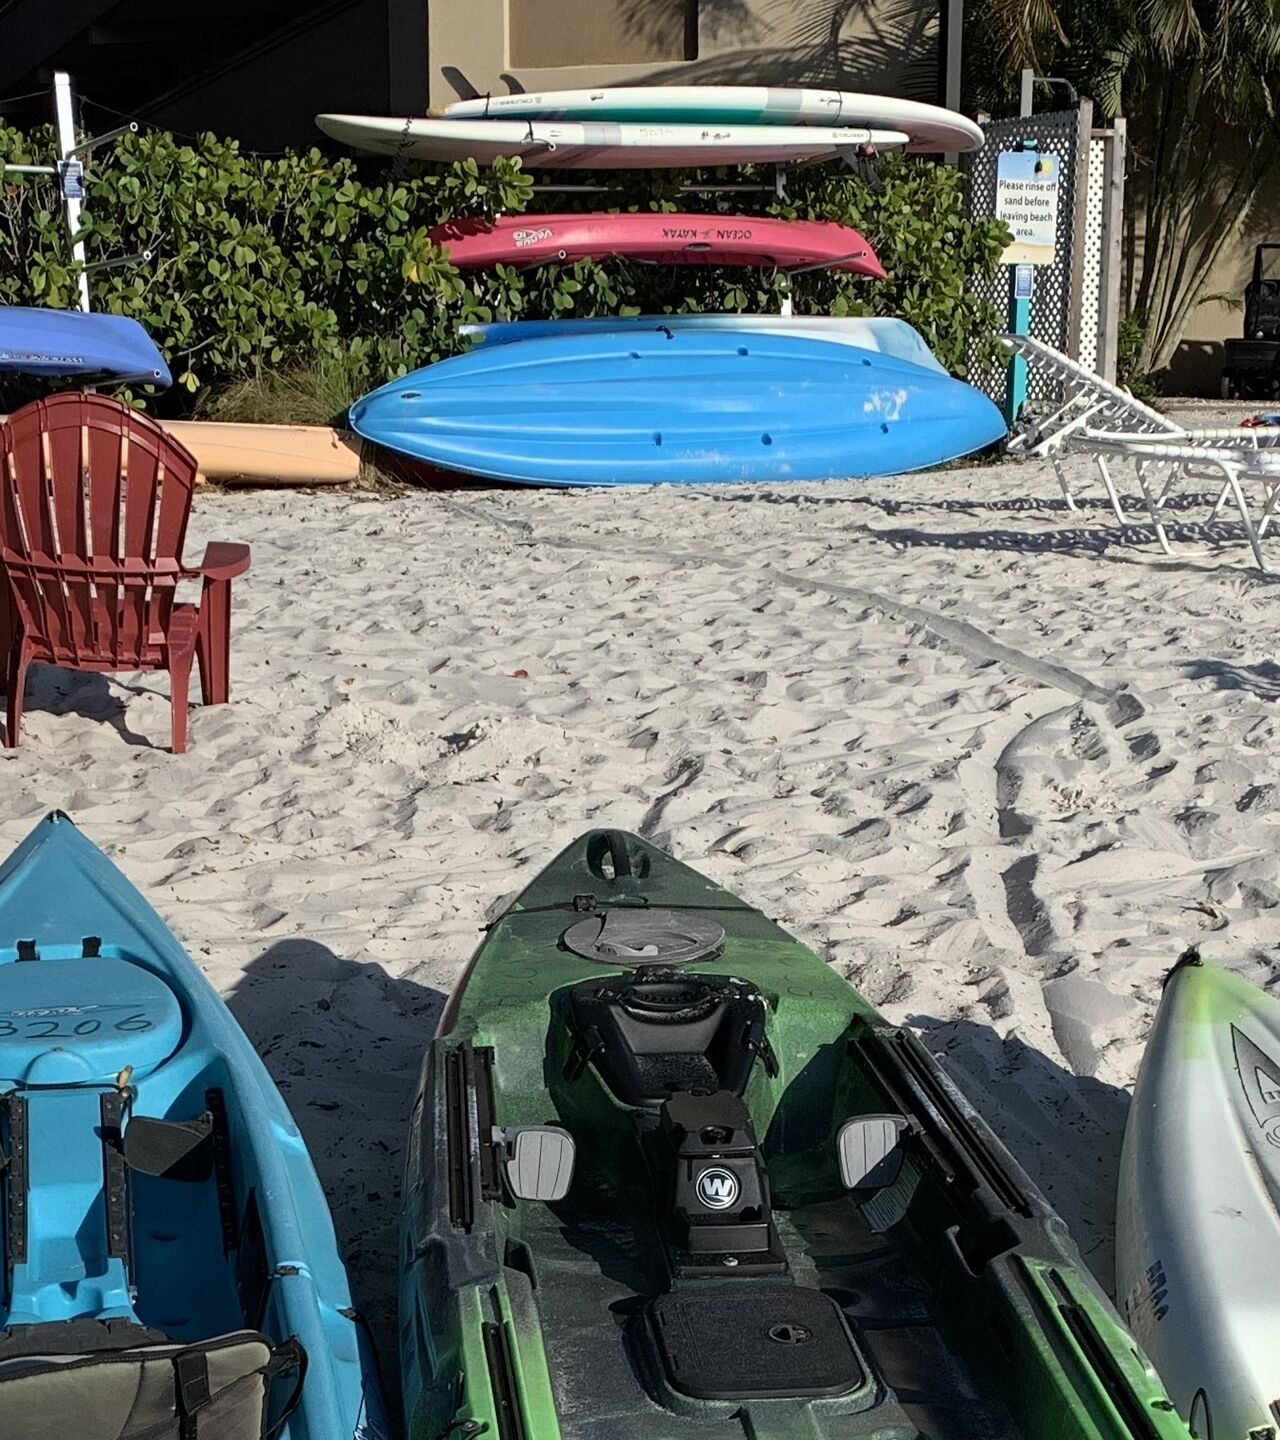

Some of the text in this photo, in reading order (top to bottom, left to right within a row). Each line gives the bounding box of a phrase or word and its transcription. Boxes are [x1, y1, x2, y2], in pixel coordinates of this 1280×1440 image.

[999, 180, 1056, 192] Please rinse off
[1004, 196, 1050, 206] sand before
[1000, 211, 1053, 223] leaving beach
[661, 228, 752, 239] OCEAN KAYAK
[1016, 228, 1035, 236] area.
